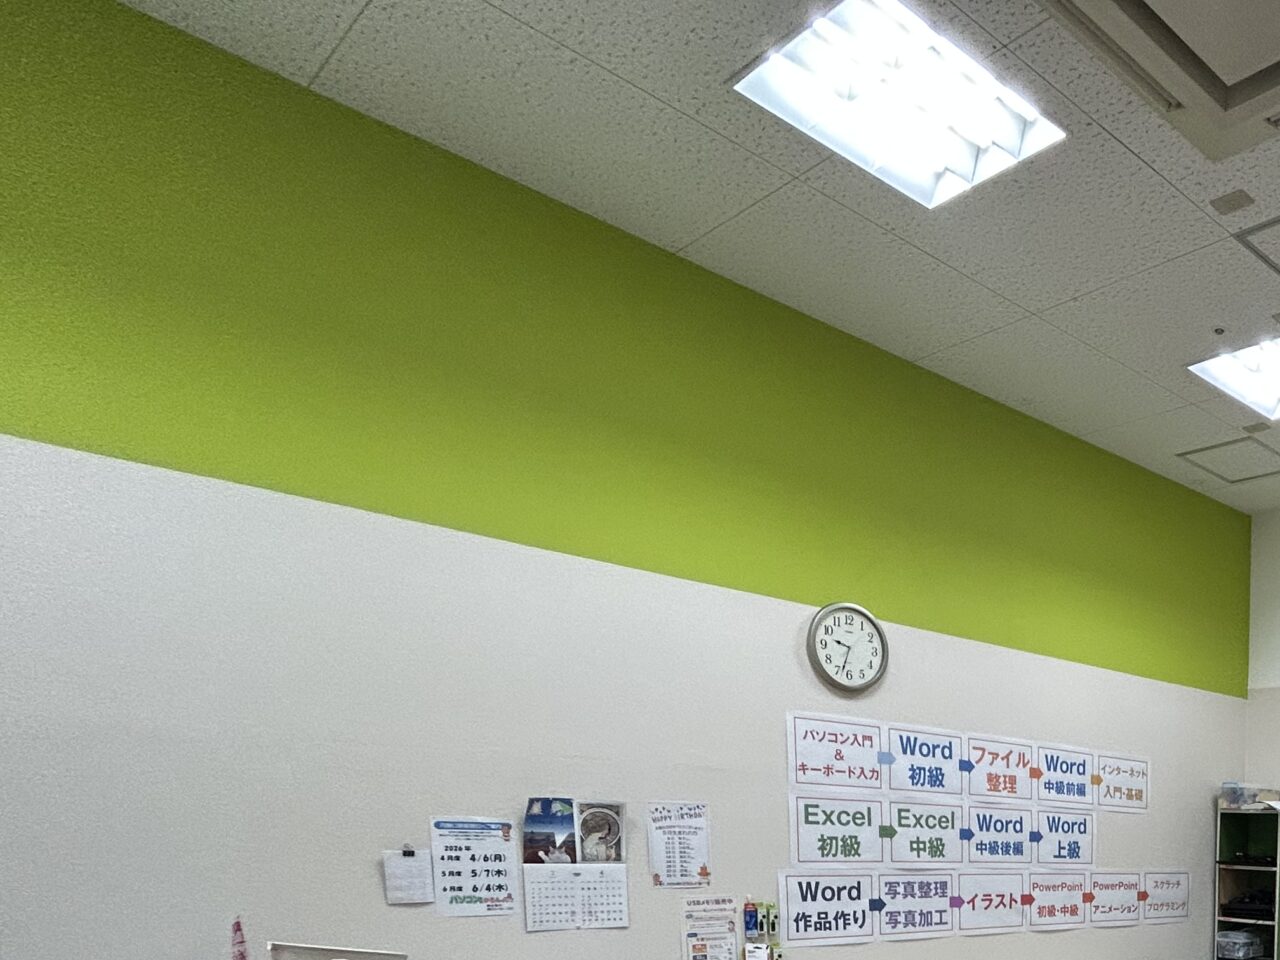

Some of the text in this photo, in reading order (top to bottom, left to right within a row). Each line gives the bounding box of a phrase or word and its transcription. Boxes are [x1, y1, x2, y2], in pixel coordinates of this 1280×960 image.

[833, 616, 840, 627] 11
[845, 614, 854, 625] 12
[860, 621, 864, 631] 1
[824, 625, 833, 636] 10
[868, 632, 873, 643] 2
[820, 639, 827, 649] 9
[825, 654, 832, 664] 8
[872, 647, 877, 657] 3
[835, 666, 840, 675] 7
[868, 660, 873, 669] 4
[846, 670, 852, 680] 6
[859, 669, 865, 679] 5
[899, 734, 953, 760] Word
[834, 749, 844, 761] &
[972, 746, 1030, 769] ファイル
[798, 762, 879, 781] キーボード入力
[1044, 754, 1086, 776] Word
[1100, 764, 1147, 778] インターネット
[908, 764, 945, 788] 初級
[986, 772, 1018, 794] 整理
[1043, 781, 1086, 797] 中級前編
[1104, 786, 1143, 801] 入門・基礎
[804, 805, 873, 828] Excel
[897, 808, 956, 830] Excel
[976, 813, 1024, 835] Word
[1046, 815, 1087, 835] Word
[817, 835, 861, 858] 初級
[909, 837, 945, 859] 中級
[975, 840, 1024, 857] 中級後編
[1053, 841, 1081, 860] 上級
[797, 880, 862, 902] Word
[884, 881, 948, 899] 写真整理
[1032, 882, 1083, 892] PowerPoint
[1092, 881, 1138, 891] PowerPoint
[1153, 880, 1181, 890] スクラッチ
[966, 892, 1019, 911] イラスト
[1093, 904, 1138, 914] アニメーション
[1147, 902, 1186, 912] プログラミング
[884, 909, 948, 928] 写真加工
[1037, 904, 1079, 918] 初級・中級
[793, 910, 867, 933] 作品作り
